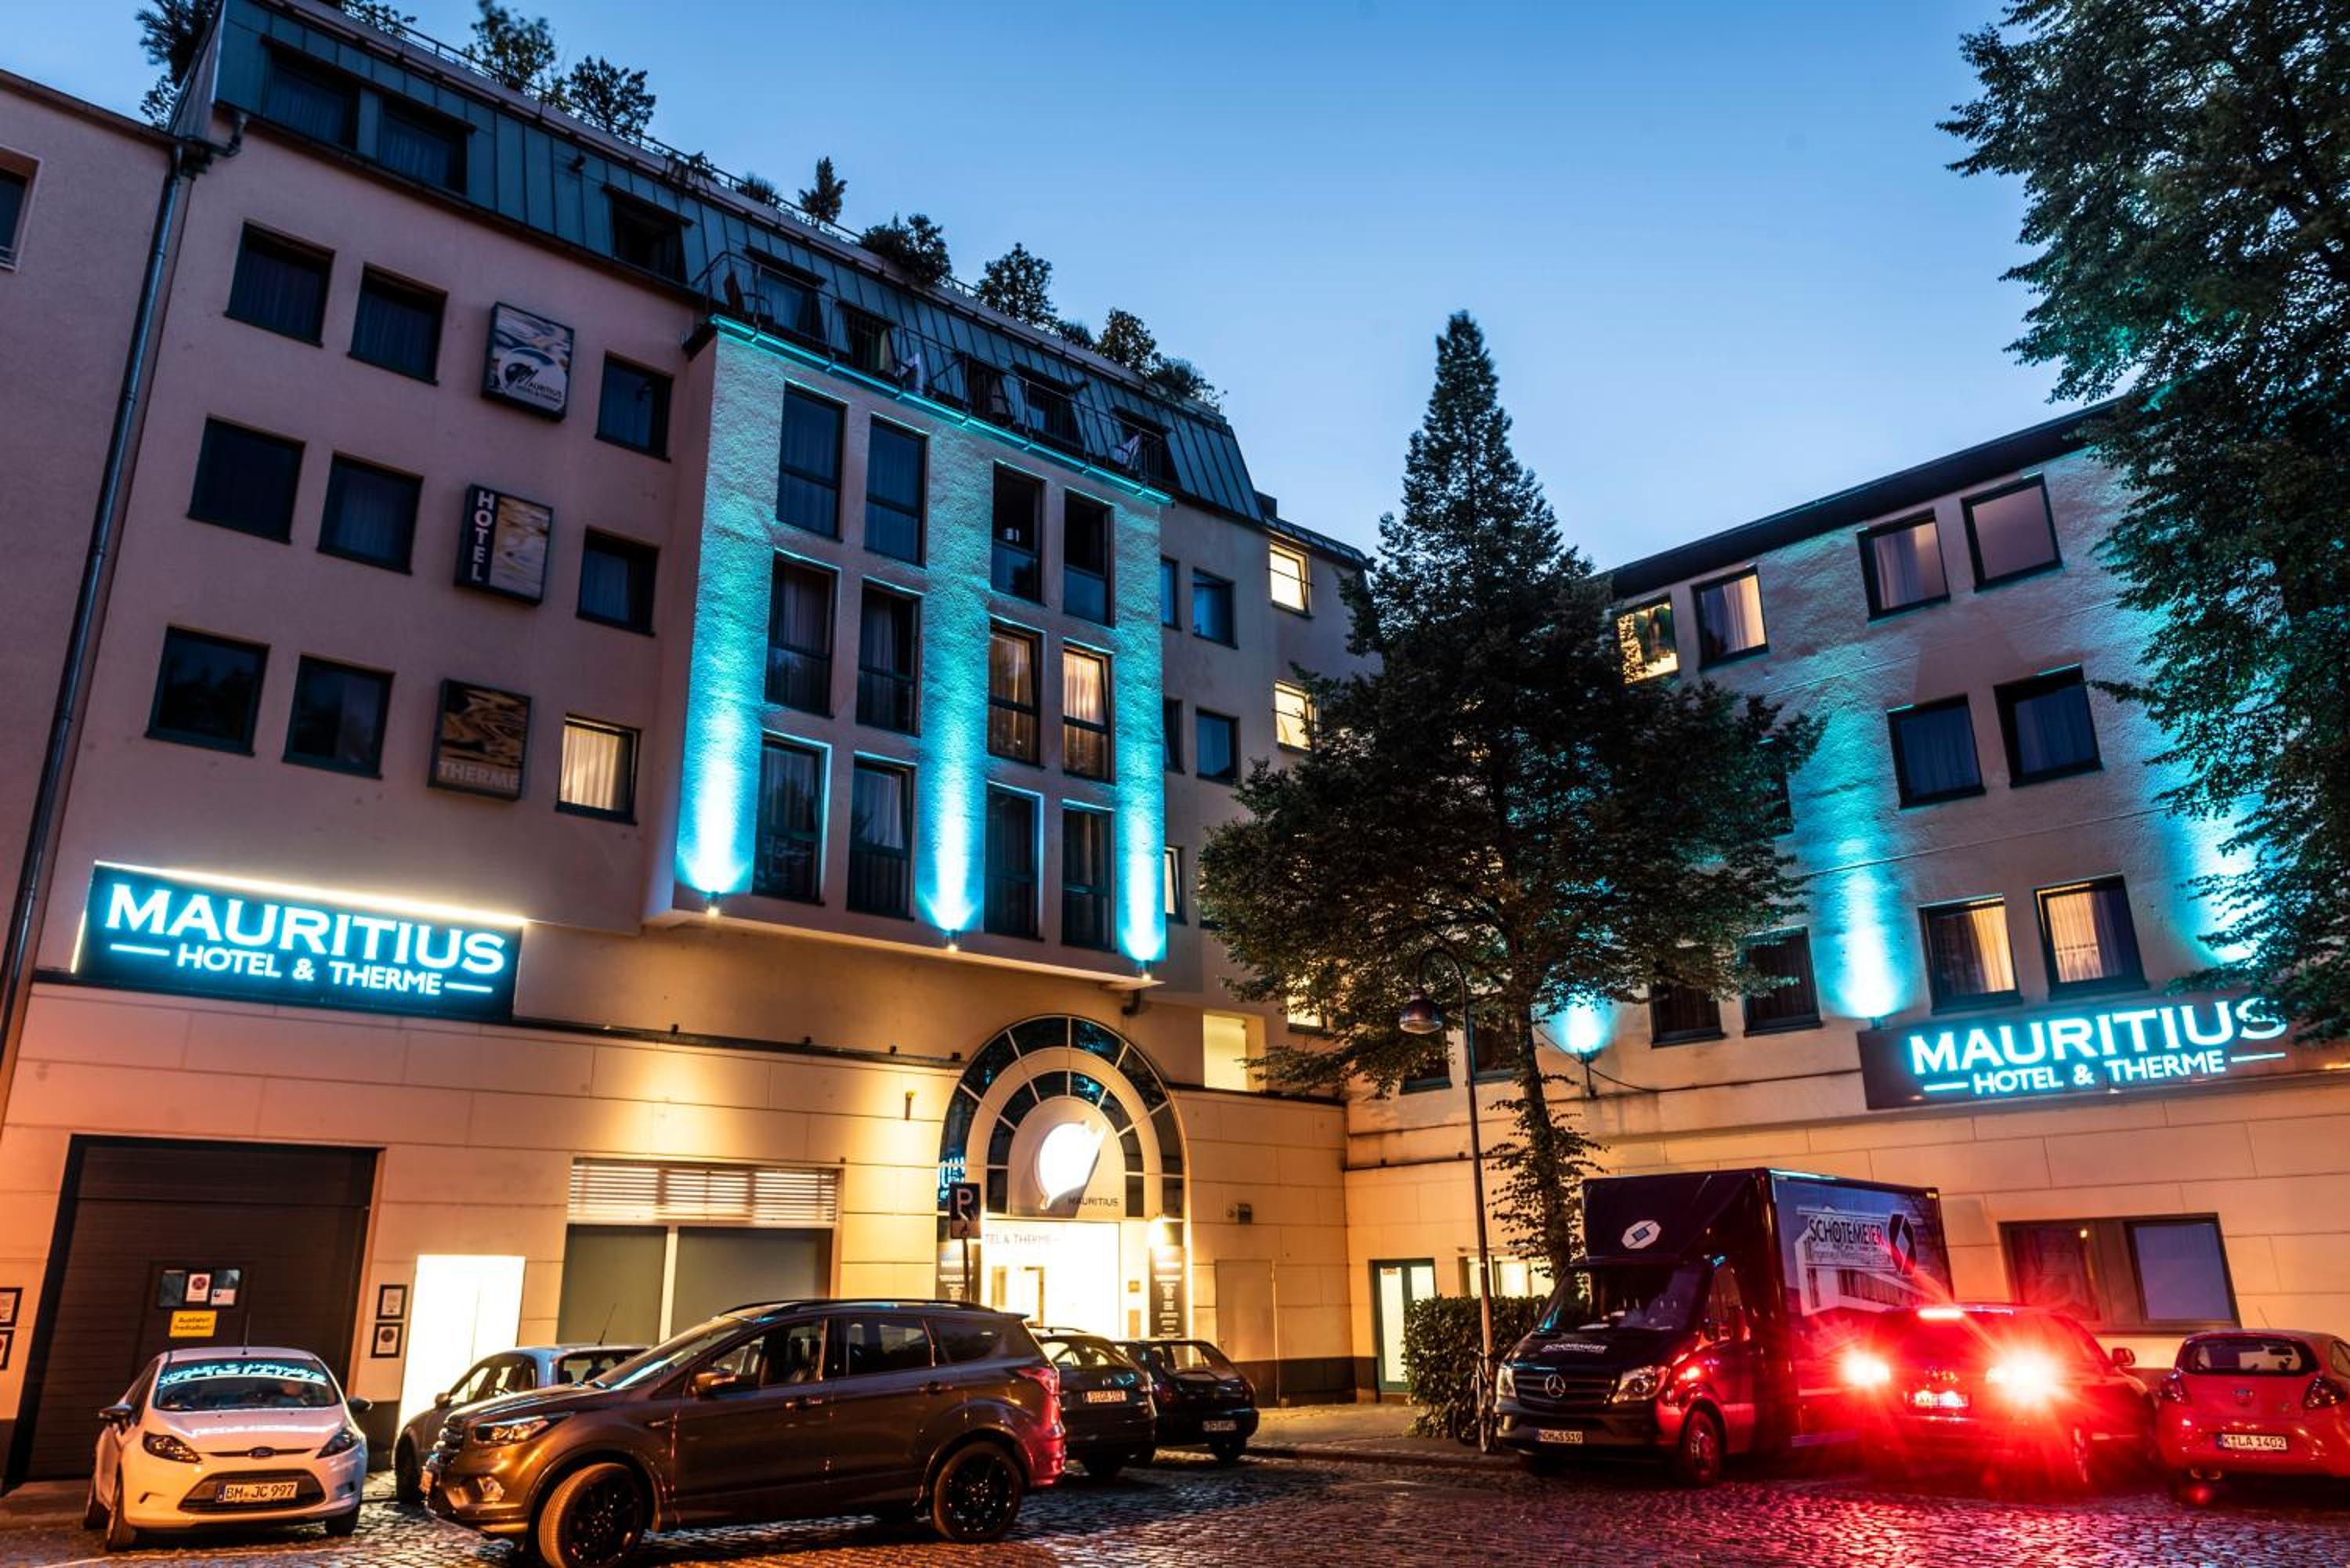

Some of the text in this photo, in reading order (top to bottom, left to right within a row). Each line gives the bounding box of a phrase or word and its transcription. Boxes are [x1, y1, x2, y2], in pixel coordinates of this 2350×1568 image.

[471, 490, 495, 581] HOTEL
[438, 761, 519, 790] THERME
[105, 883, 505, 974] MAURITIUS
[177, 945, 443, 996] HOTEL & THERME
[1908, 997, 2288, 1076] MAURITIUS
[1973, 1050, 2226, 1095] HOTEL & THERME
[956, 1187, 973, 1215] P
[1068, 1195, 1119, 1206] MAURITIUS
[2238, 1435, 2253, 1447] LA
[2257, 1436, 2285, 1448] 1402
[226, 1484, 295, 1499] BM JC 997
